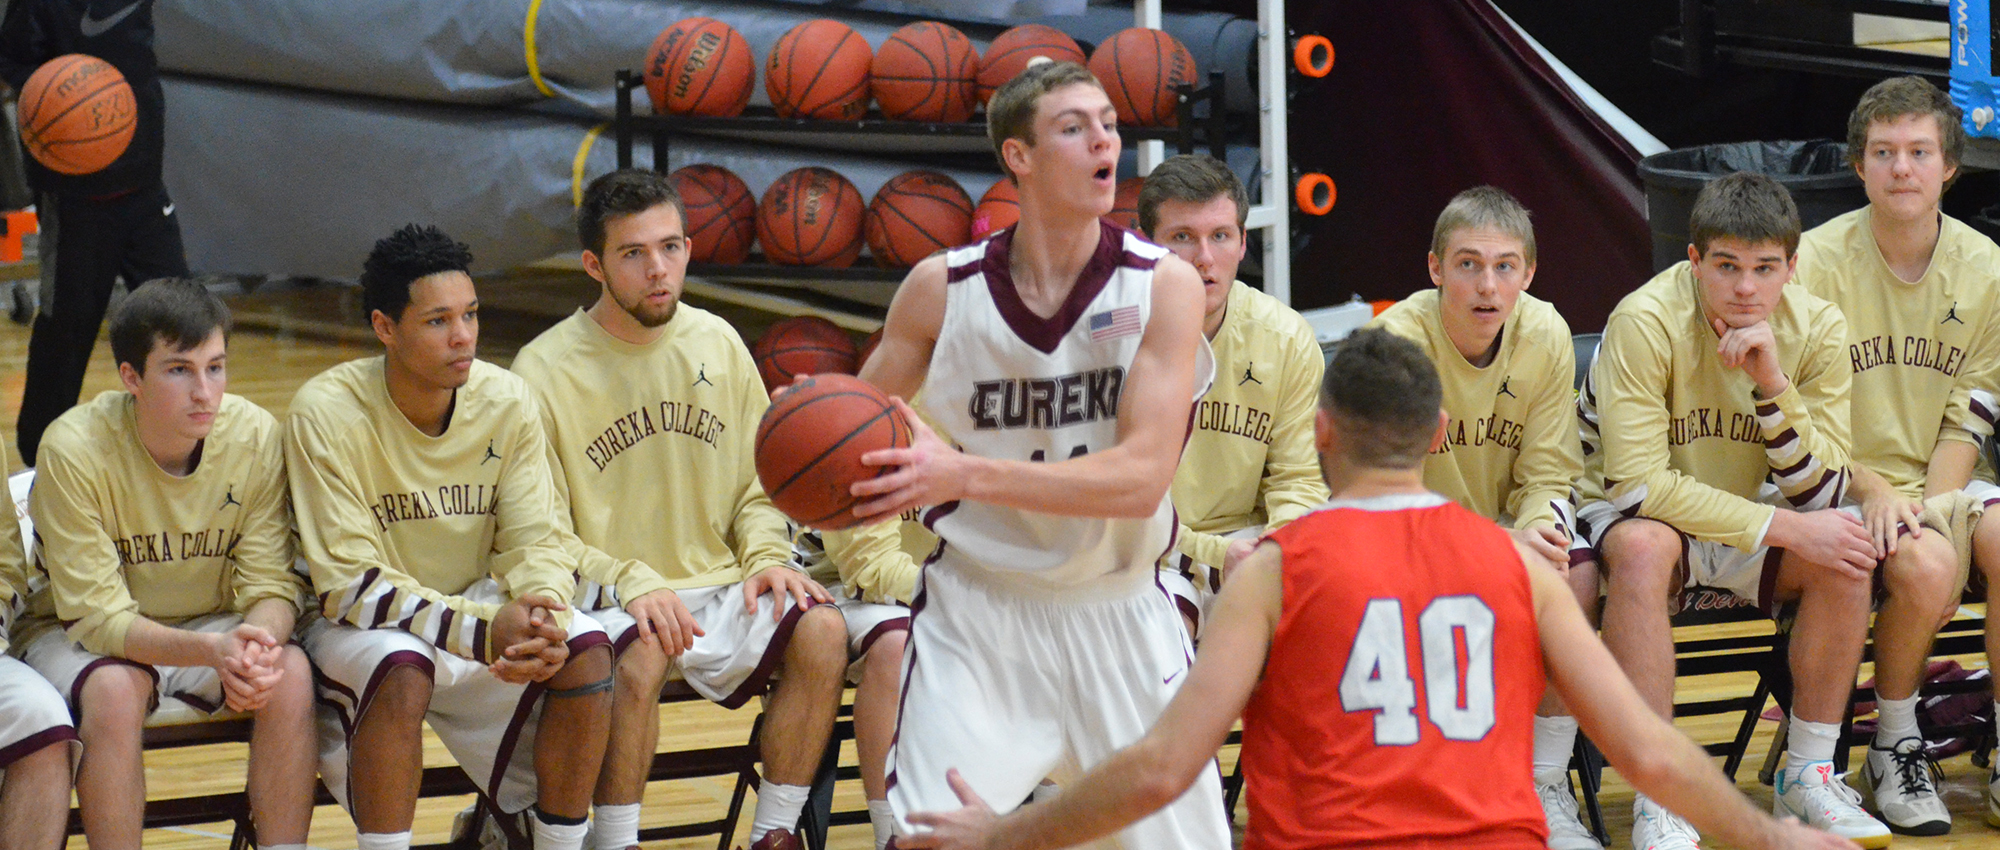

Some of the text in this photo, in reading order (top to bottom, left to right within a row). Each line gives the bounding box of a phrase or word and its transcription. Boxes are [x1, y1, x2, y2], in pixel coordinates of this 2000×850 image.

[674, 31, 721, 98] Wilson
[585, 406, 657, 473] EUREKA
[1338, 593, 1496, 747] 40
